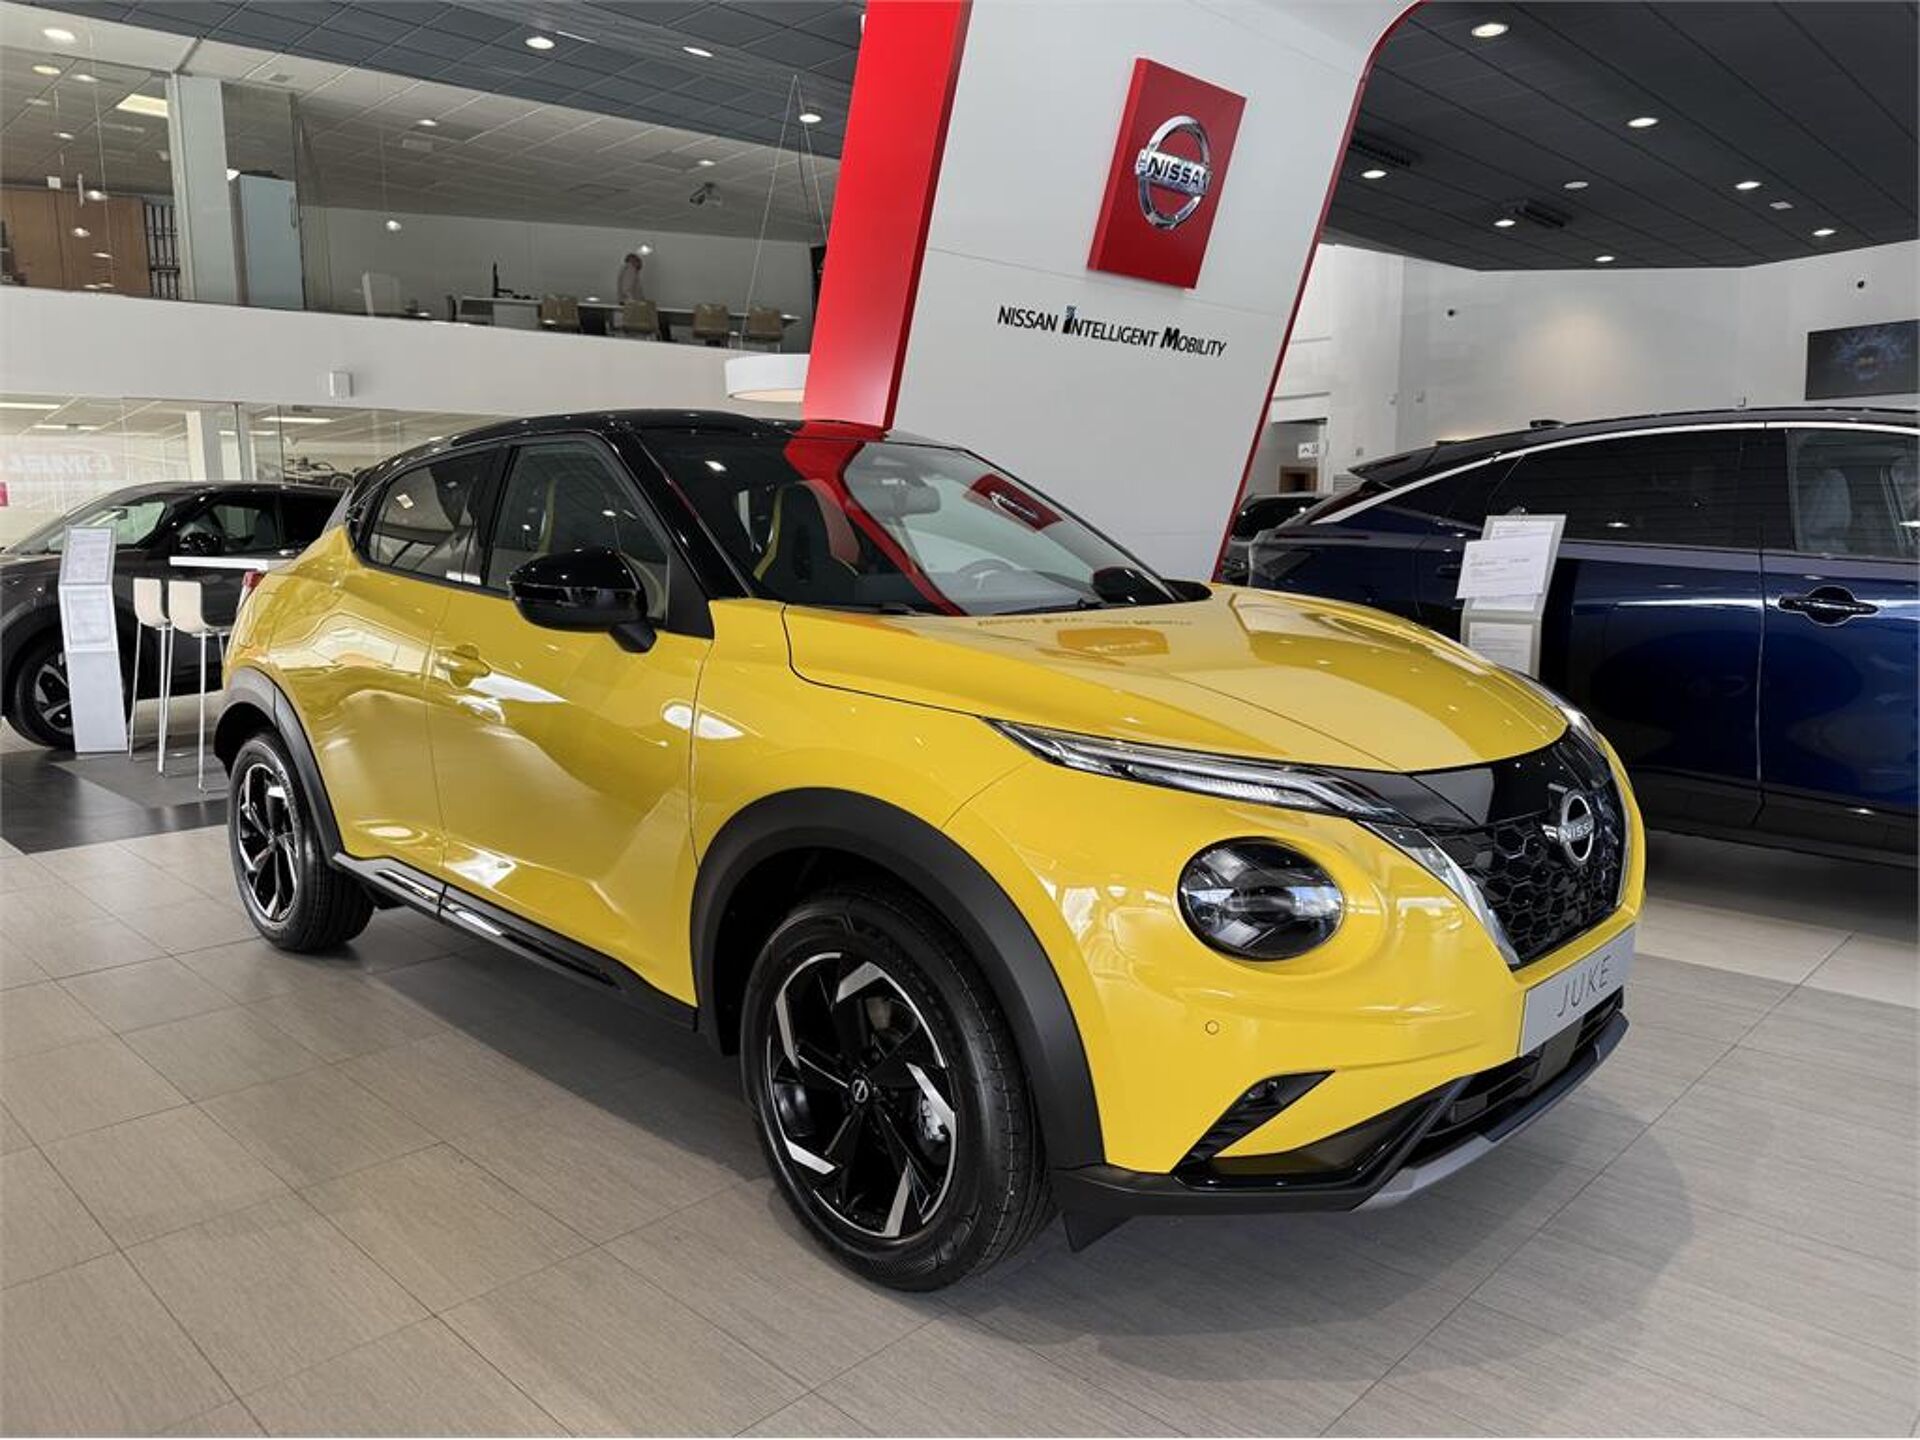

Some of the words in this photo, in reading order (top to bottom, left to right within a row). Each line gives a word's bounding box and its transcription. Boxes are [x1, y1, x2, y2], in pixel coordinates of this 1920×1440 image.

[997, 305, 1058, 333] NISSAN
[1062, 305, 1159, 348] INTELLIGENT
[1160, 326, 1227, 357] MOBILITY
[1557, 954, 1612, 1018] JUKE
